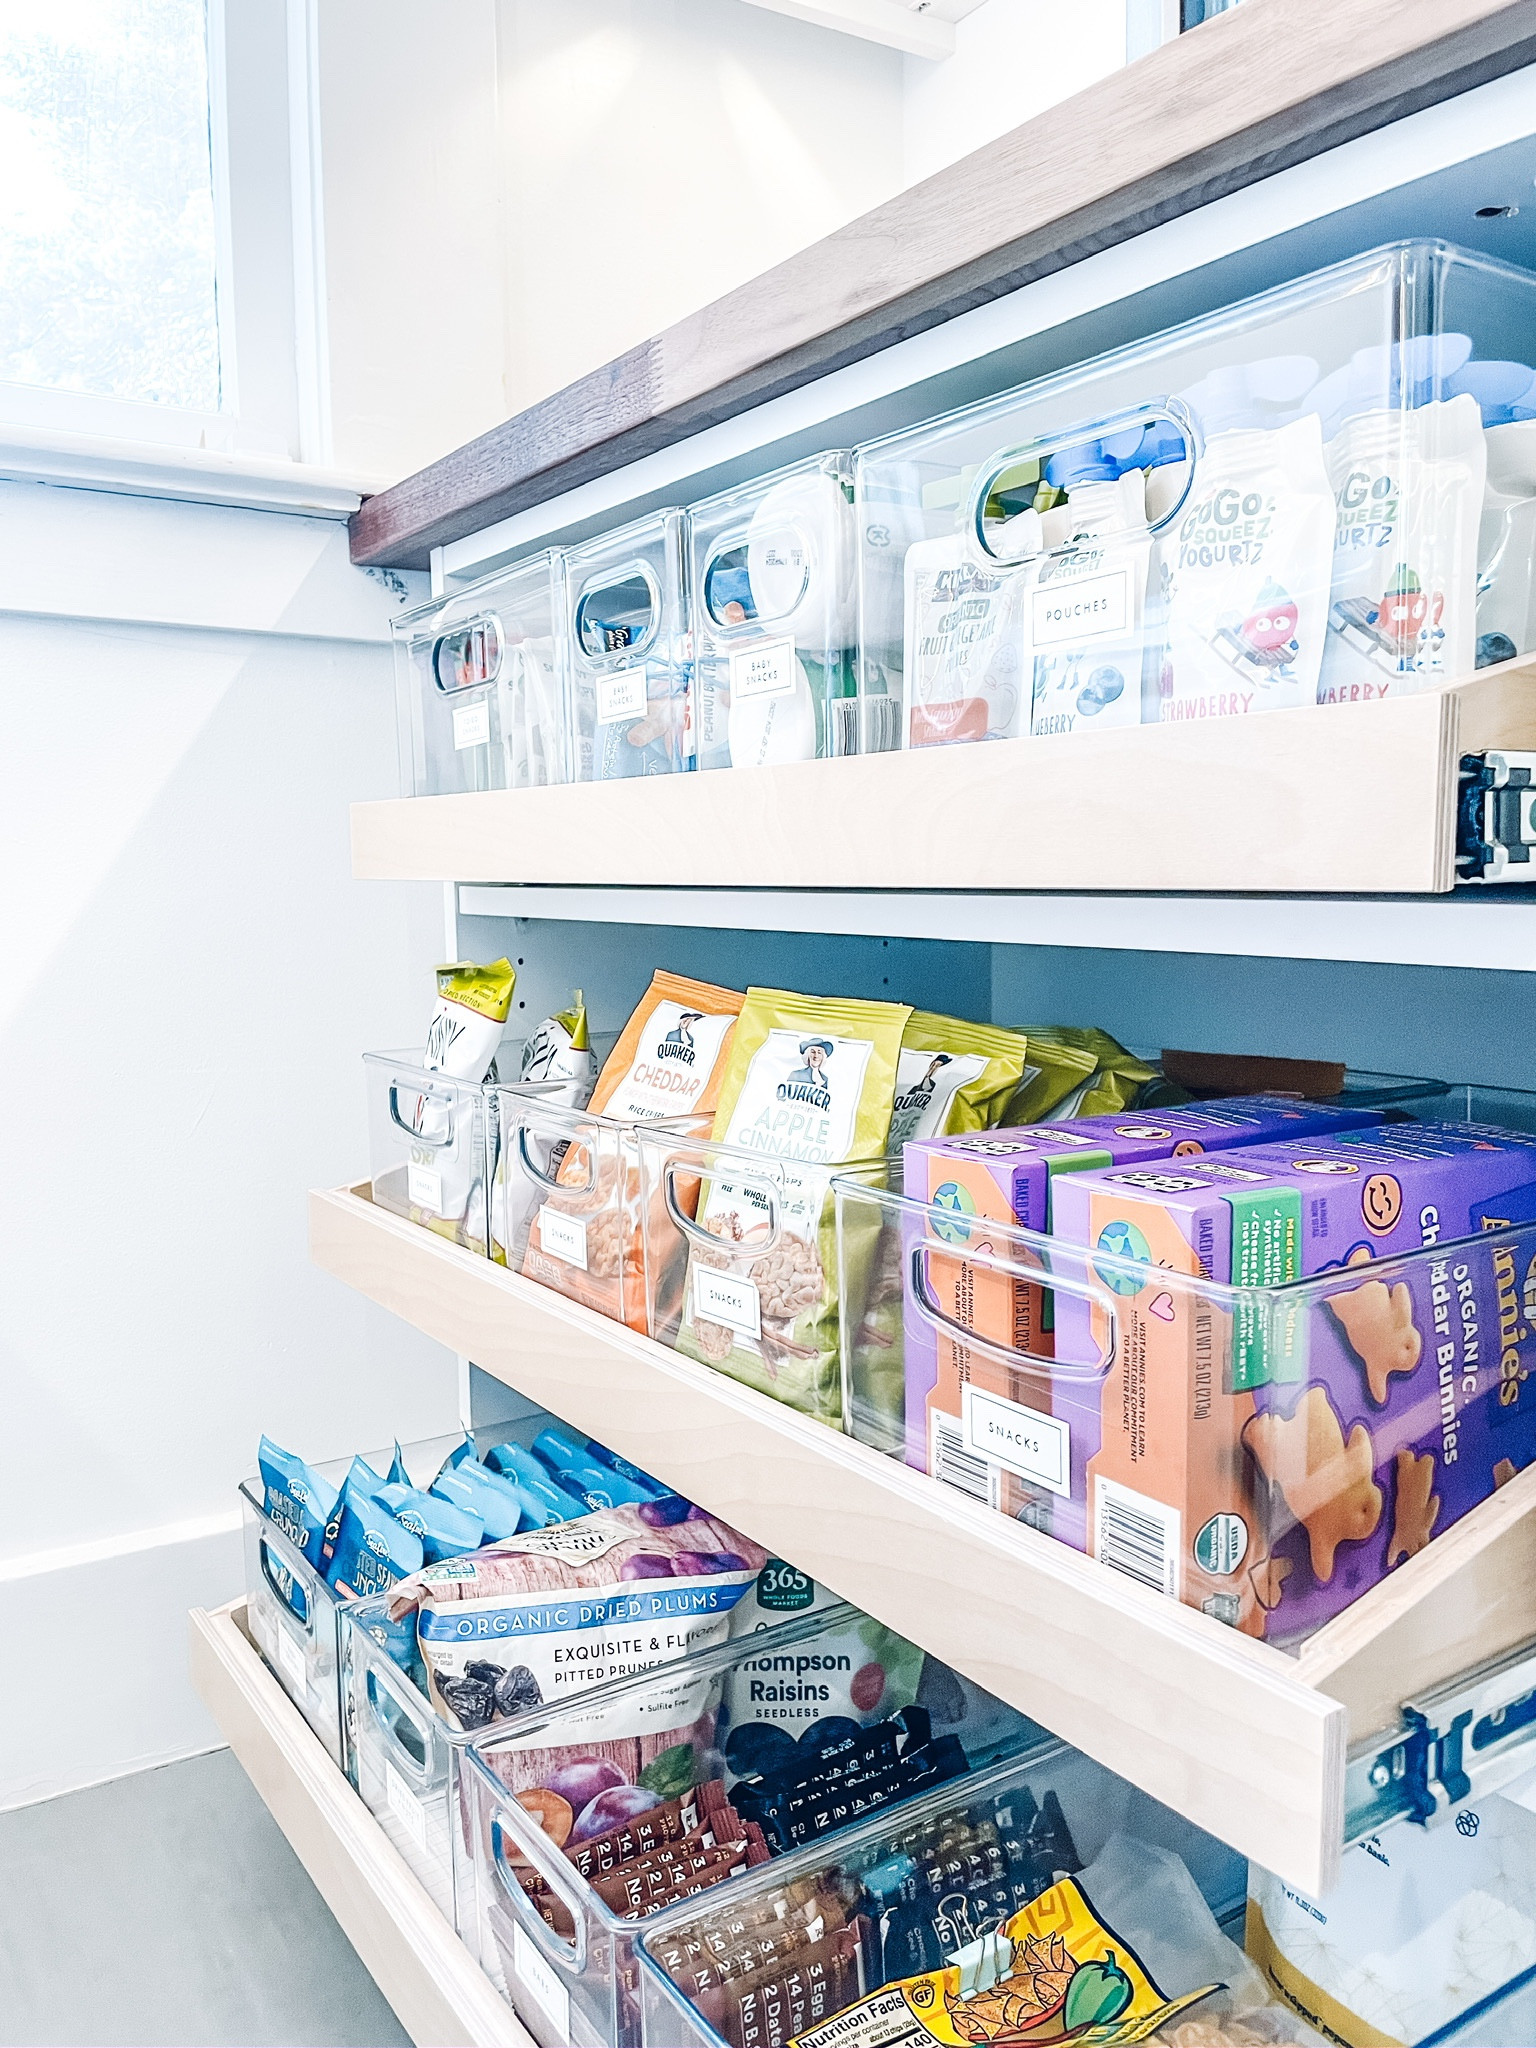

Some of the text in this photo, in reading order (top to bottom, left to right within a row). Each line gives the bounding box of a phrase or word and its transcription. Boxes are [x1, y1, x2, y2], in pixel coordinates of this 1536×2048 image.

[1179, 540, 1264, 569] YOGURTZ
[1046, 599, 1108, 622] POUCHES
[751, 658, 772, 672] BABY
[746, 671, 779, 686] SNACKS
[1162, 692, 1254, 722] STRAWBERRY
[657, 1043, 696, 1068] QUAKER
[633, 1063, 701, 1097] CHEDDAR
[776, 1083, 831, 1112] QUAKER
[628, 1104, 644, 1116] RICE
[755, 1106, 830, 1145] APPLE
[1015, 1178, 1029, 1208] BAKED
[1242, 1221, 1250, 1247] not
[1273, 1219, 1282, 1239] No
[1250, 1220, 1260, 1270] Cheese
[1263, 1219, 1272, 1285] synthetic
[1285, 1217, 1295, 1283] Made wit
[710, 1289, 742, 1309] SNACKS
[1015, 1299, 1030, 1314] 7.5
[1015, 1315, 1030, 1328] OZ
[1193, 1219, 1214, 1420] BAKED NET WT 7.5 OZ (213g)
[1452, 1263, 1478, 1394] ORGANIC
[1124, 1334, 1130, 1346] TO
[1123, 1347, 1130, 1355] A
[1137, 1321, 1146, 1458] VISIT ANNIES.COM TO LEARN
[1436, 1341, 1461, 1466] Bunnies
[988, 1421, 1040, 1454] SNACKS
[1129, 1396, 1138, 1463] COMMITMENT
[763, 1566, 808, 1592] 365
[456, 1591, 718, 1637] ORGANIC DRIED PLUMS
[554, 1637, 660, 1663] EXQUISITE &
[555, 1668, 604, 1683] PITTED
[750, 1680, 829, 1701] Raisins
[647, 1701, 673, 1712] Sulfite
[755, 1708, 819, 1718] SEEDLESS
[640, 1824, 652, 1837] 3
[598, 1842, 612, 1855] 2
[620, 1833, 633, 1853] 14
[988, 1847, 1001, 1858] 6
[661, 1851, 673, 1863] 3
[693, 1856, 706, 1868] 3
[949, 1860, 962, 1872] 2
[969, 1855, 981, 1865] 4
[650, 1871, 662, 1884] 2
[671, 1863, 686, 1884] 14
[628, 1877, 643, 1905] No
[996, 1890, 1007, 1902] 6
[1015, 1882, 1026, 1895] 3
[978, 1899, 988, 1912] 4
[731, 1921, 745, 1934] 3
[935, 1916, 951, 1943] No
[710, 1931, 726, 1952] 14
[761, 1939, 775, 1953] 3
[717, 1960, 731, 1973] 2
[740, 1950, 755, 1971] 14
[810, 1962, 827, 2018] 3 Egg
[915, 1988, 931, 2003] GF
[741, 1992, 757, 2023] No
[788, 1973, 805, 2035] 14 Pea
[764, 1984, 783, 2048] 2 Date
[801, 1996, 906, 2048] Nutrition Facts
[850, 2018, 890, 2041] per container
[890, 2025, 904, 2035] chips
